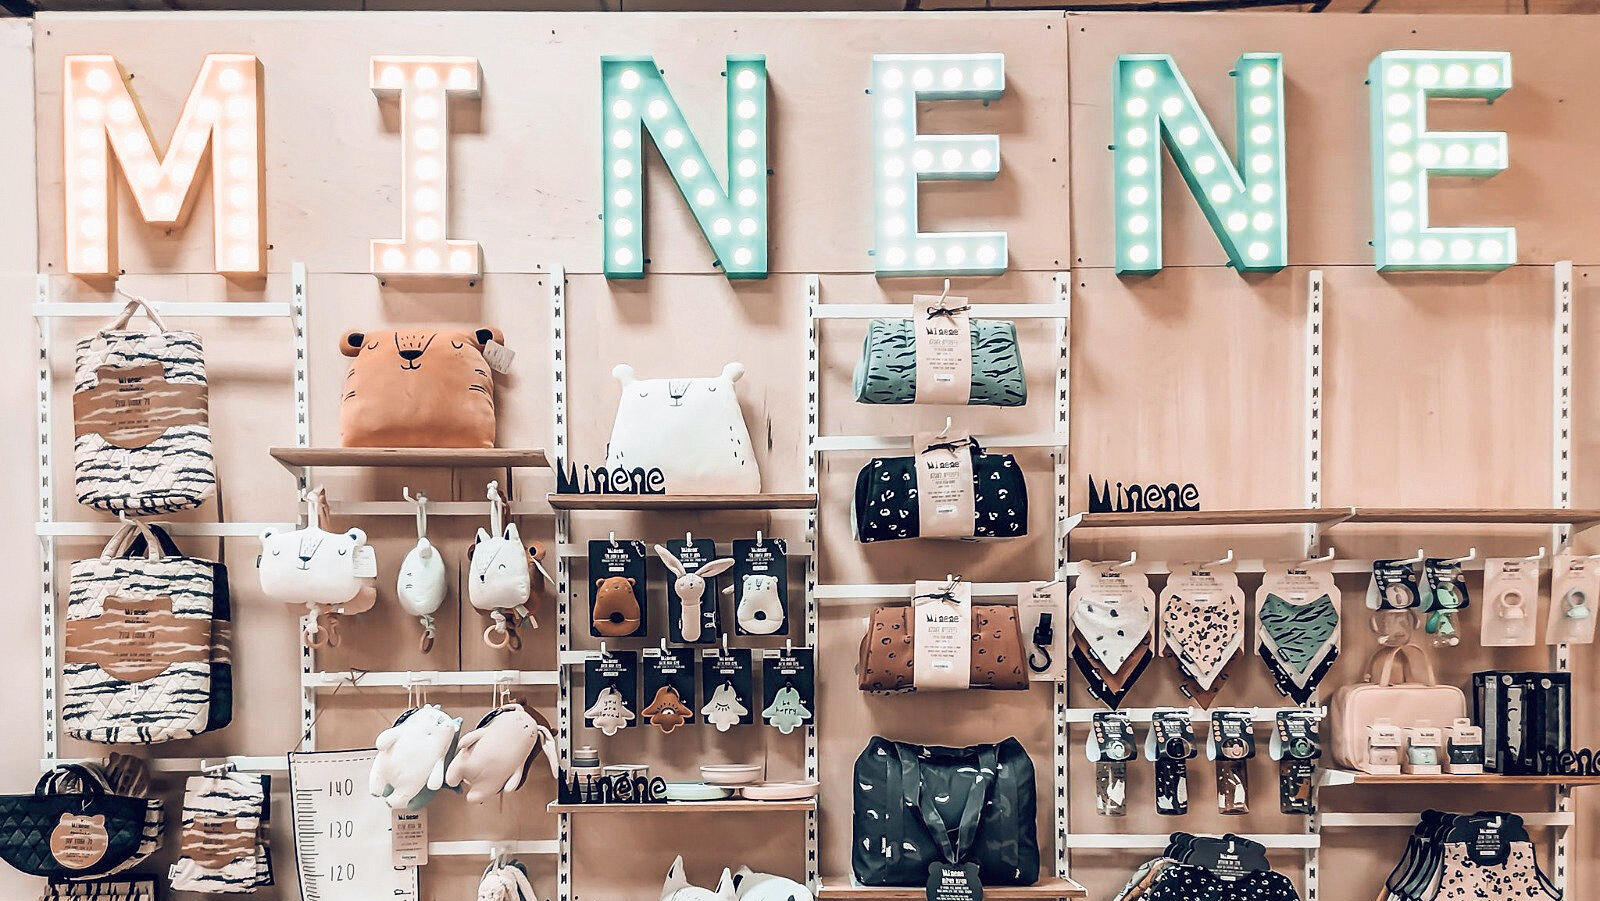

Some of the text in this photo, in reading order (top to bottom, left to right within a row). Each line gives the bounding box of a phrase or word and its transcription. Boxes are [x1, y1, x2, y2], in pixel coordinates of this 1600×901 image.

[64, 50, 1517, 279] MINENE
[557, 456, 666, 494] Minene
[1088, 473, 1200, 512] Minene
[329, 778, 354, 797] 140
[558, 766, 668, 803] Minene
[329, 820, 354, 839] 130
[330, 863, 355, 882] 120
